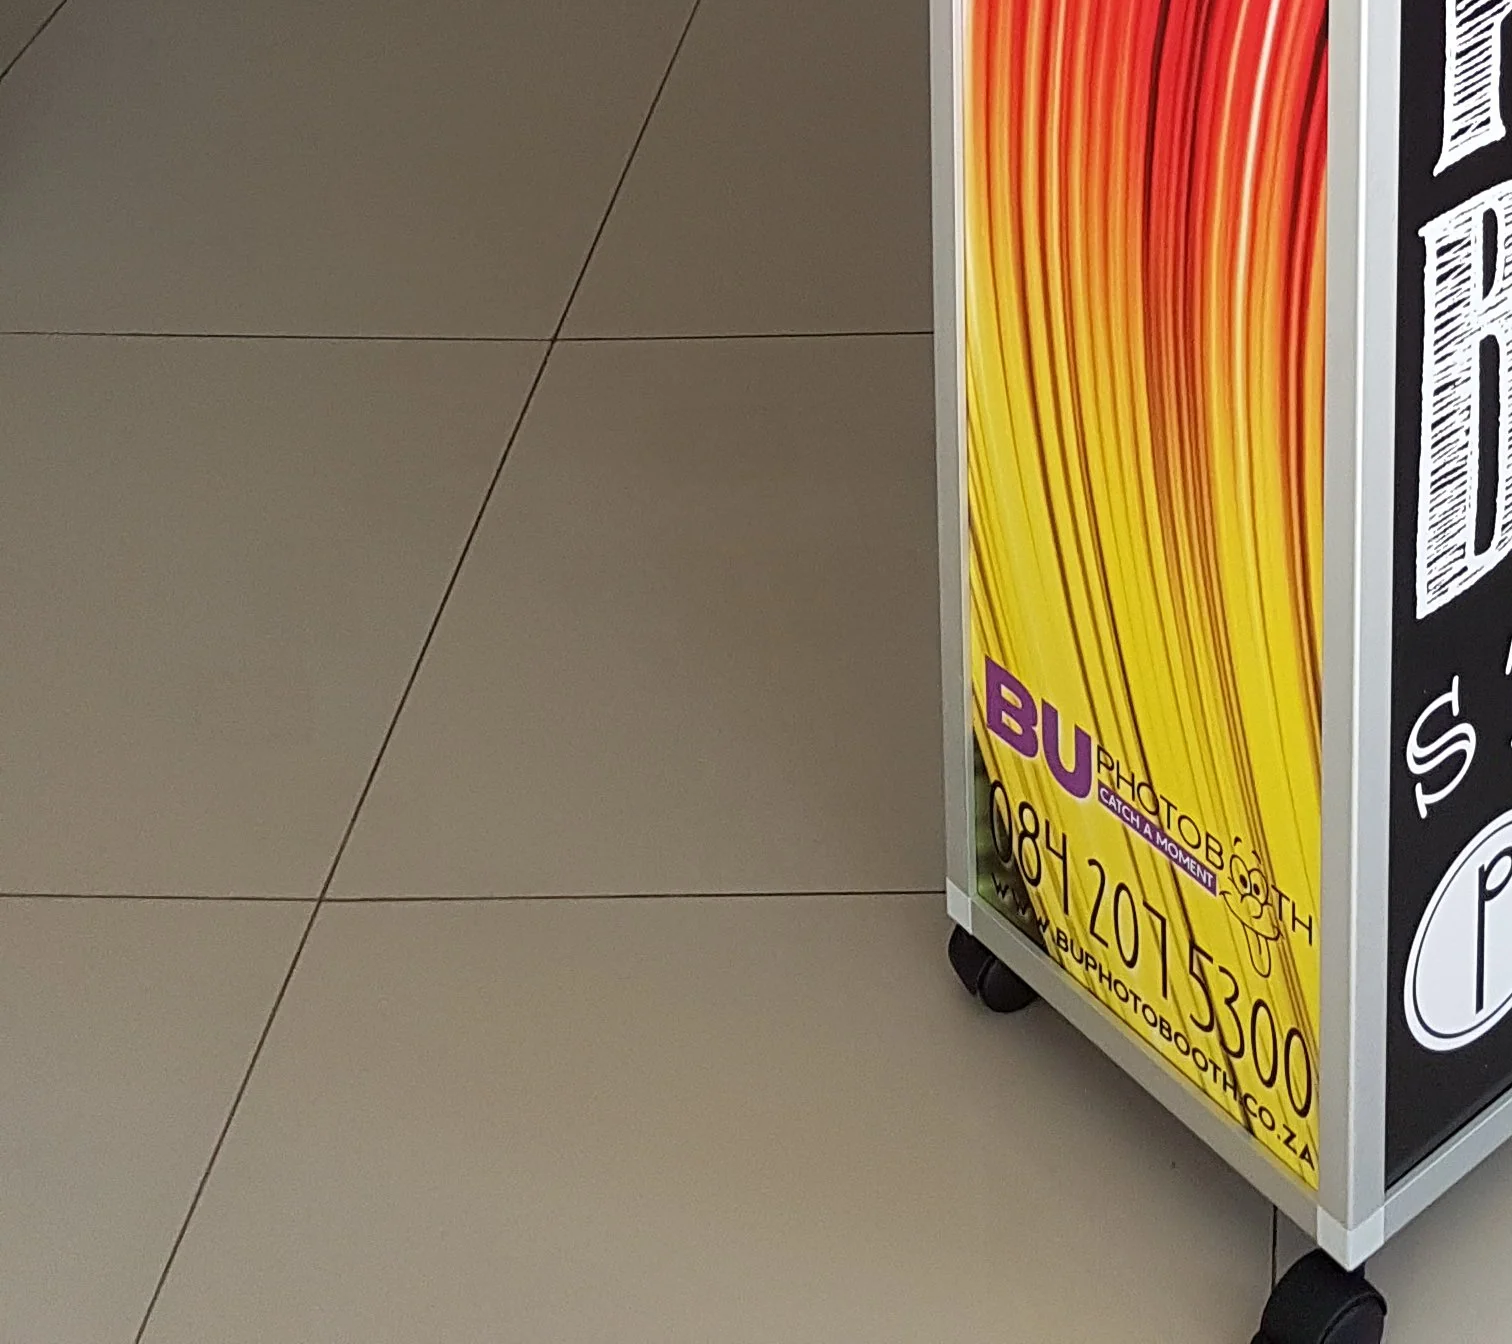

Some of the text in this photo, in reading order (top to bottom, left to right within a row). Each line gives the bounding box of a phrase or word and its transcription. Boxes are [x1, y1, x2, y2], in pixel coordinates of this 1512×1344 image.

[985, 655, 1093, 799] BU
[1100, 787, 1216, 887] CATCH A MOMENT
[989, 780, 1312, 1119] 084 207 5300
